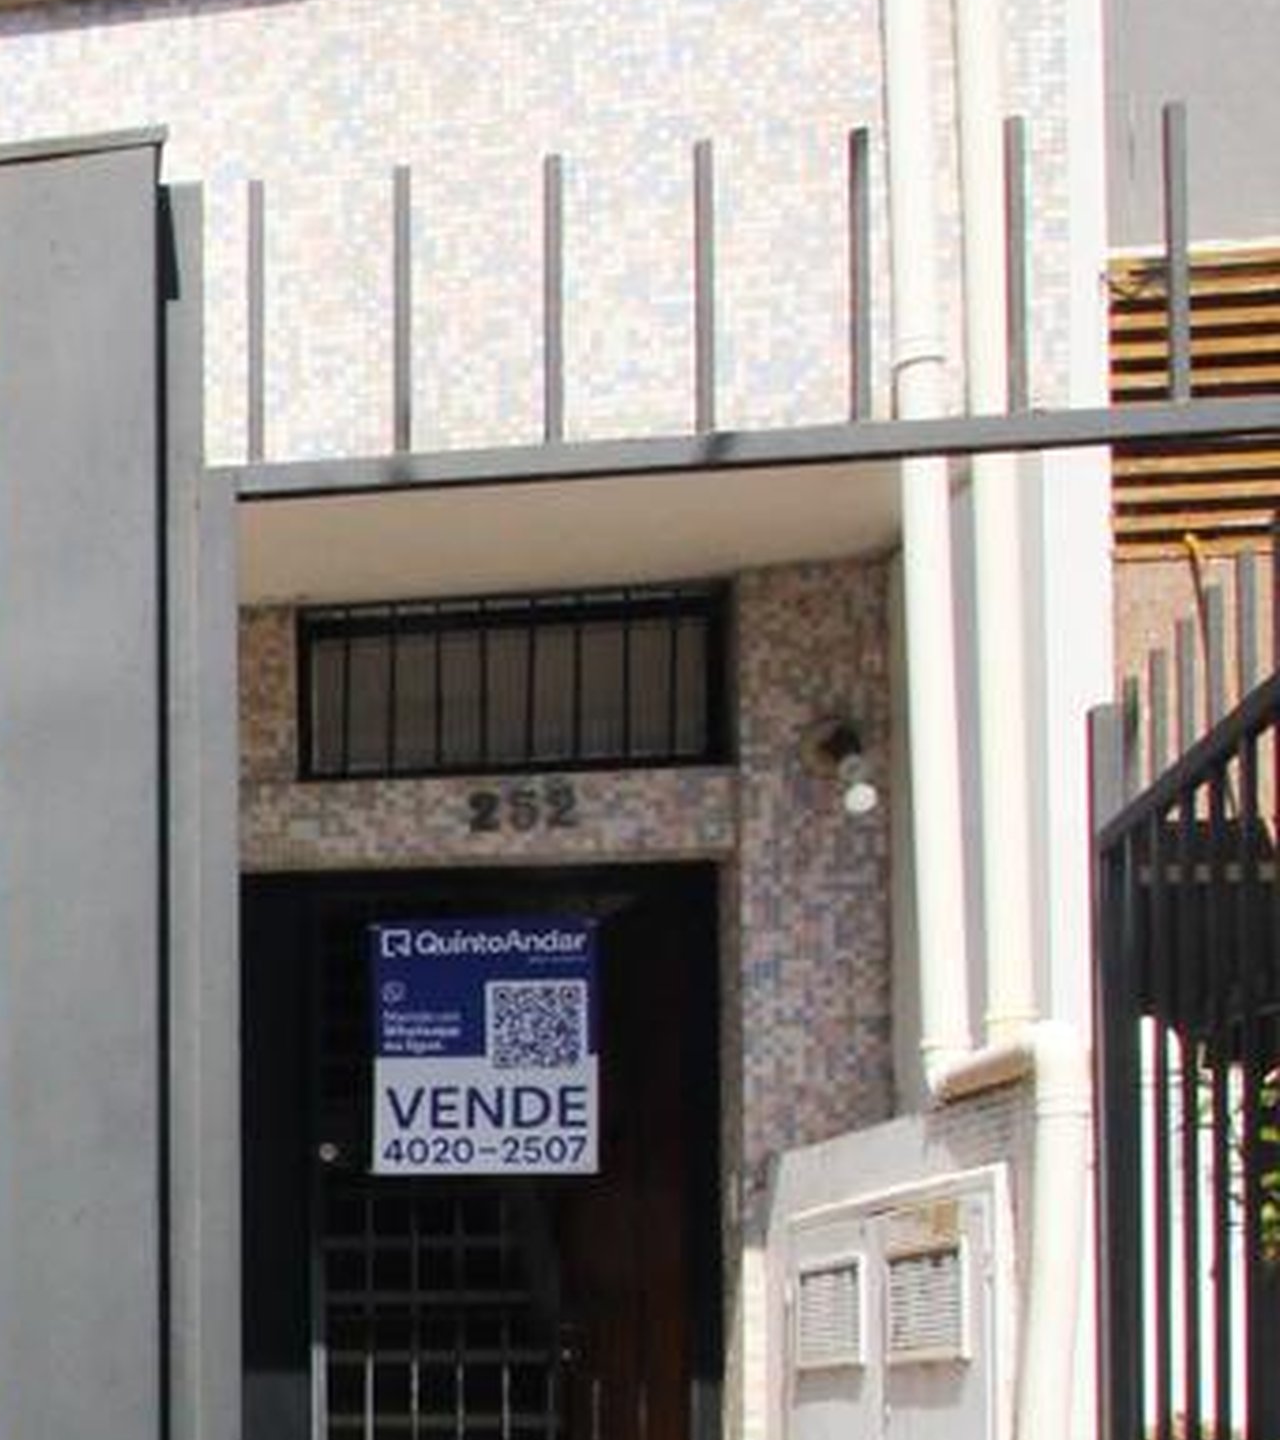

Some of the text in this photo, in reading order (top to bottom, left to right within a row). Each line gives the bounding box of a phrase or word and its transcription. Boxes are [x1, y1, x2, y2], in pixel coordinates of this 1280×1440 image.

[415, 929, 587, 955] QuintoAndar
[386, 1086, 589, 1129] VENDE
[383, 1137, 587, 1164] 4020-2507
